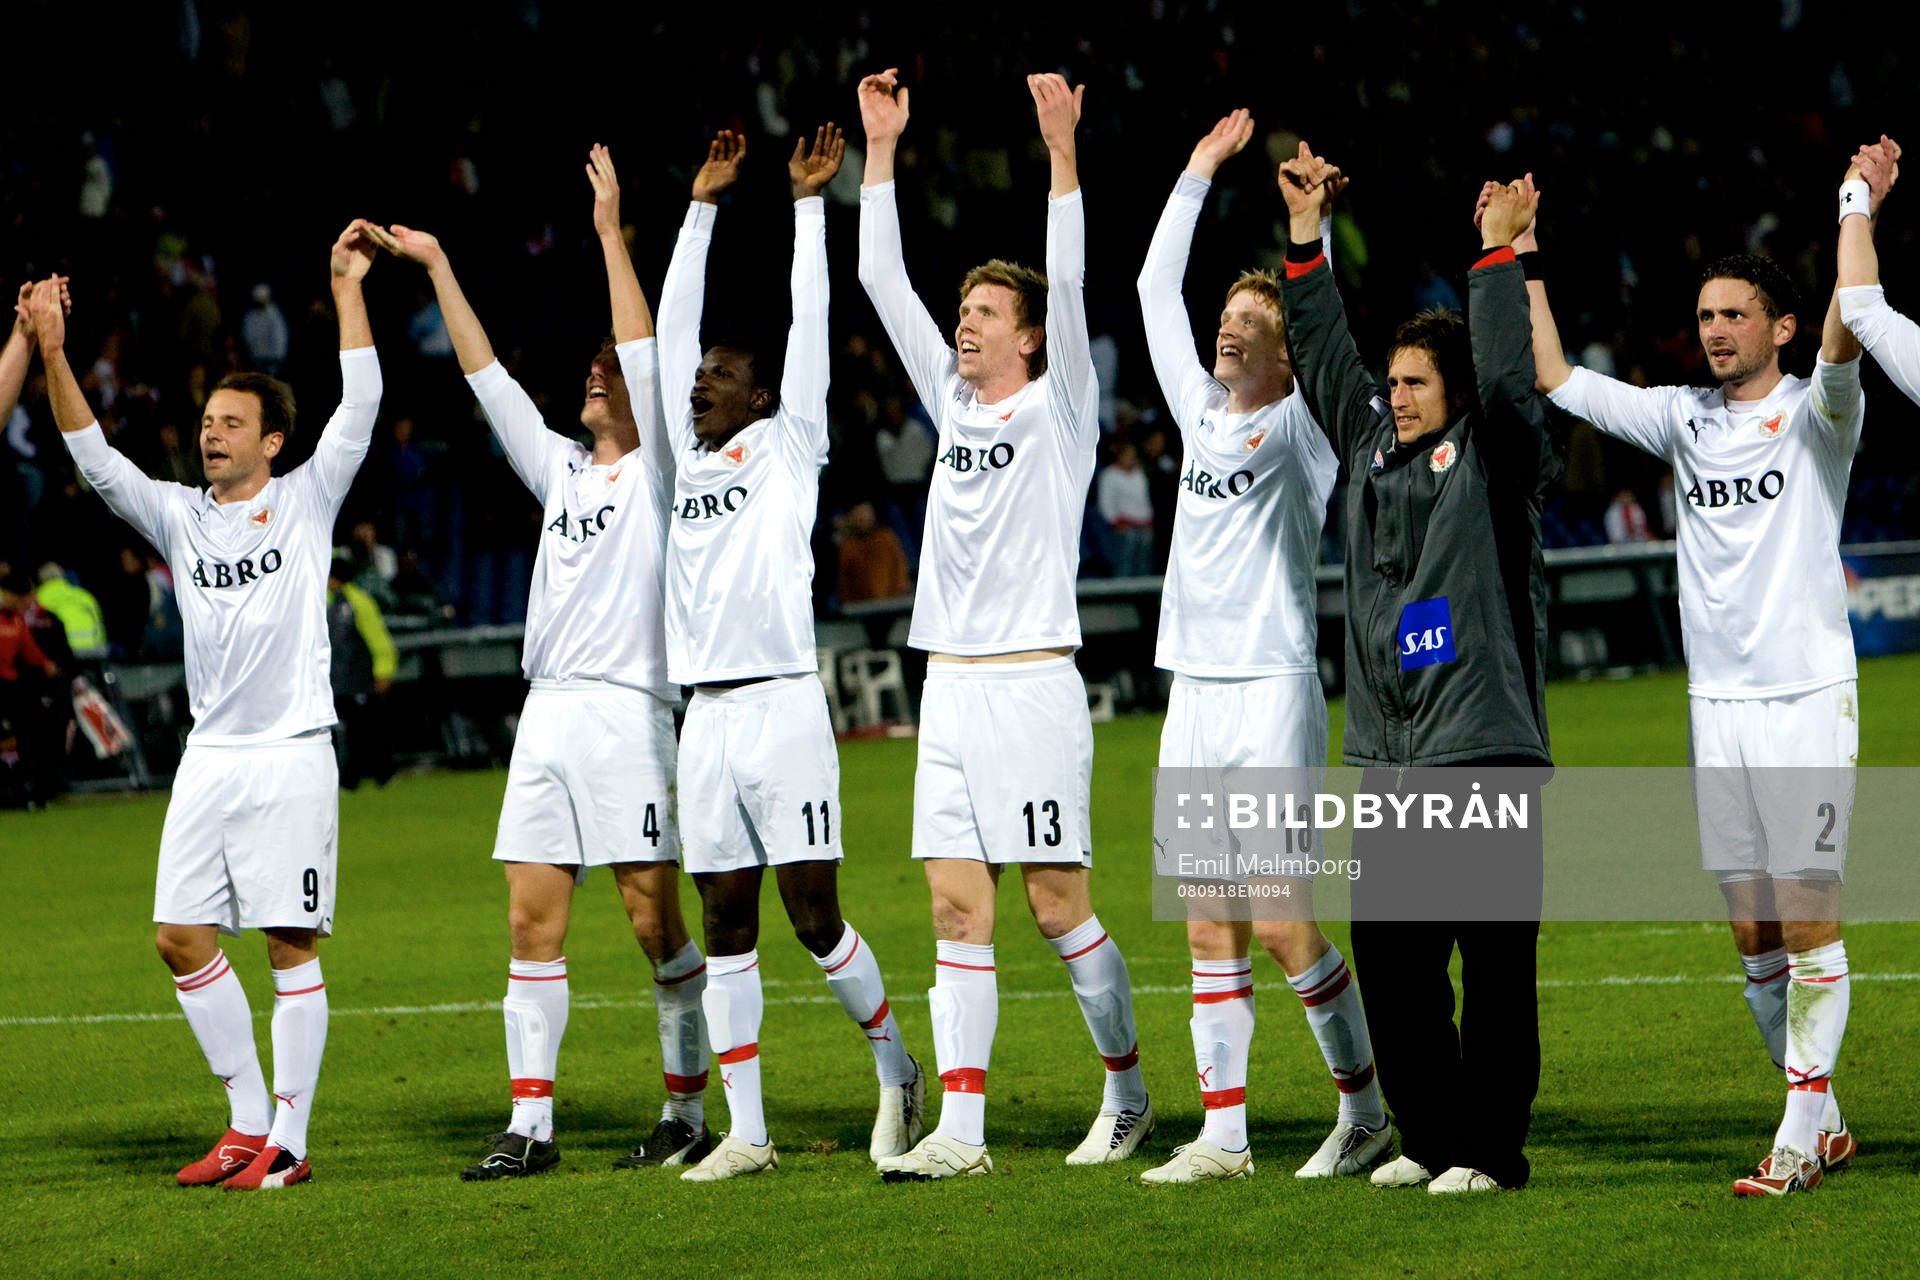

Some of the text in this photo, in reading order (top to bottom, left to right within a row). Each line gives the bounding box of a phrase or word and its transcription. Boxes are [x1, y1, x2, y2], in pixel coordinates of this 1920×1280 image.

[671, 486, 748, 520] BRO
[192, 548, 282, 588] ÅBRO
[1402, 626, 1447, 655] SAS
[642, 803, 660, 847] 4
[801, 800, 830, 846] 11
[1022, 799, 1062, 847] 13
[1280, 804, 1312, 854] 18
[1815, 802, 1836, 852] 2
[303, 867, 318, 913] 9
